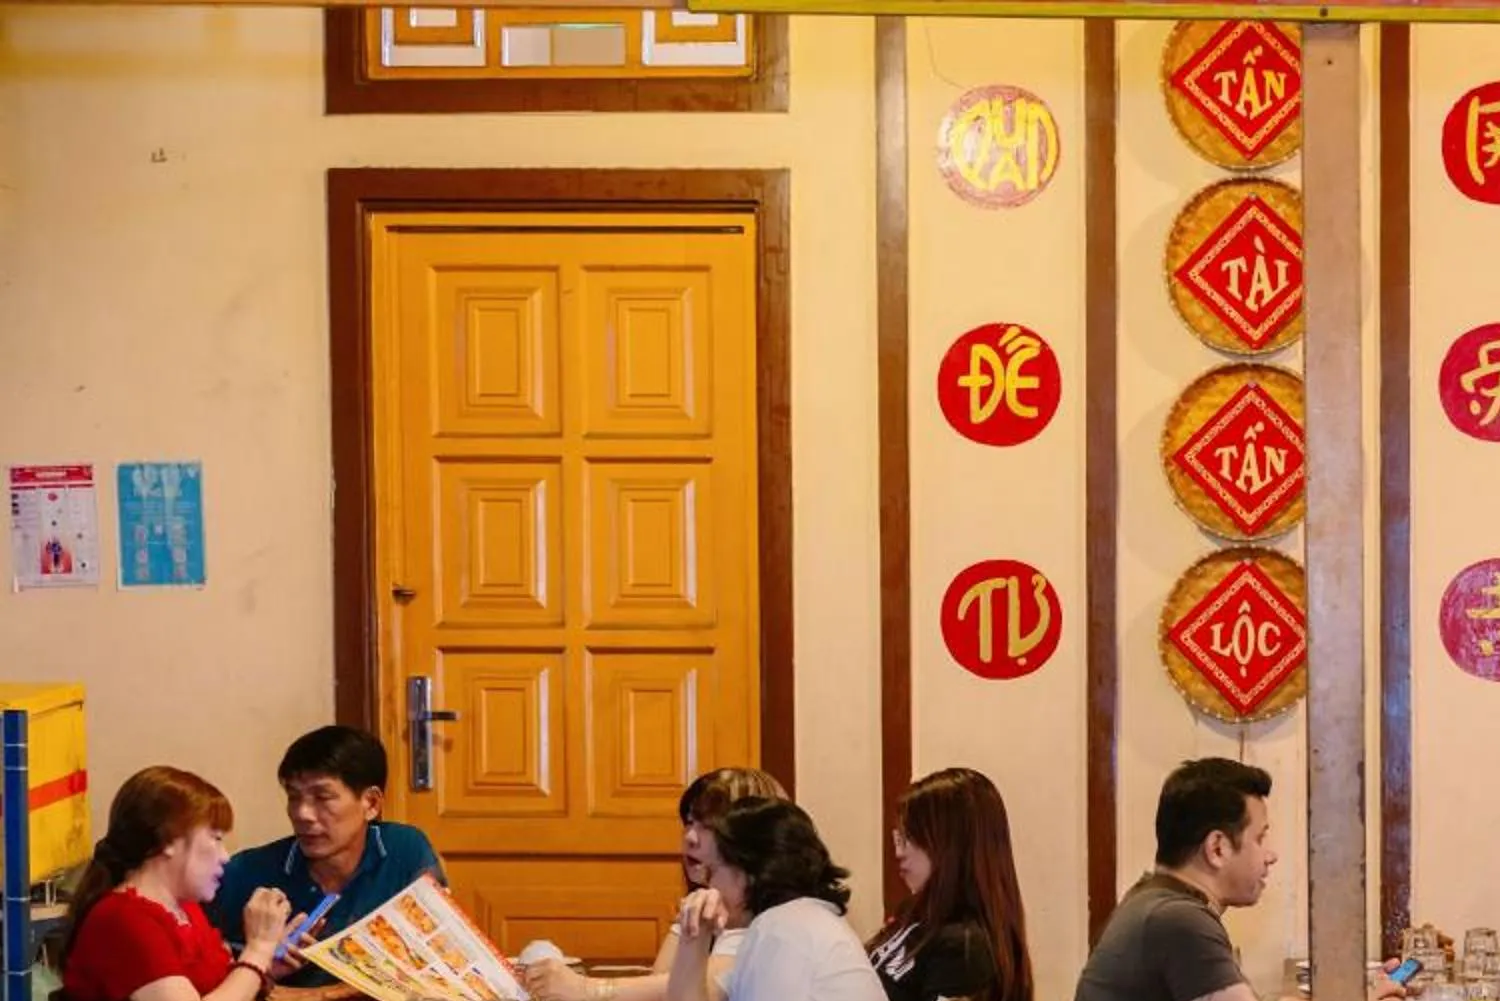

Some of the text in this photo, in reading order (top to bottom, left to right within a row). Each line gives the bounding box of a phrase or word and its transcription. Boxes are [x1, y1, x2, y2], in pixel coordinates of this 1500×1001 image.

[1213, 45, 1287, 120] TẤN
[1220, 234, 1290, 313] TÀI
[957, 325, 1041, 423] ĐẾ
[1214, 421, 1288, 495] TẤN
[957, 573, 1050, 665] TỰ
[1210, 600, 1281, 677] LỘC
